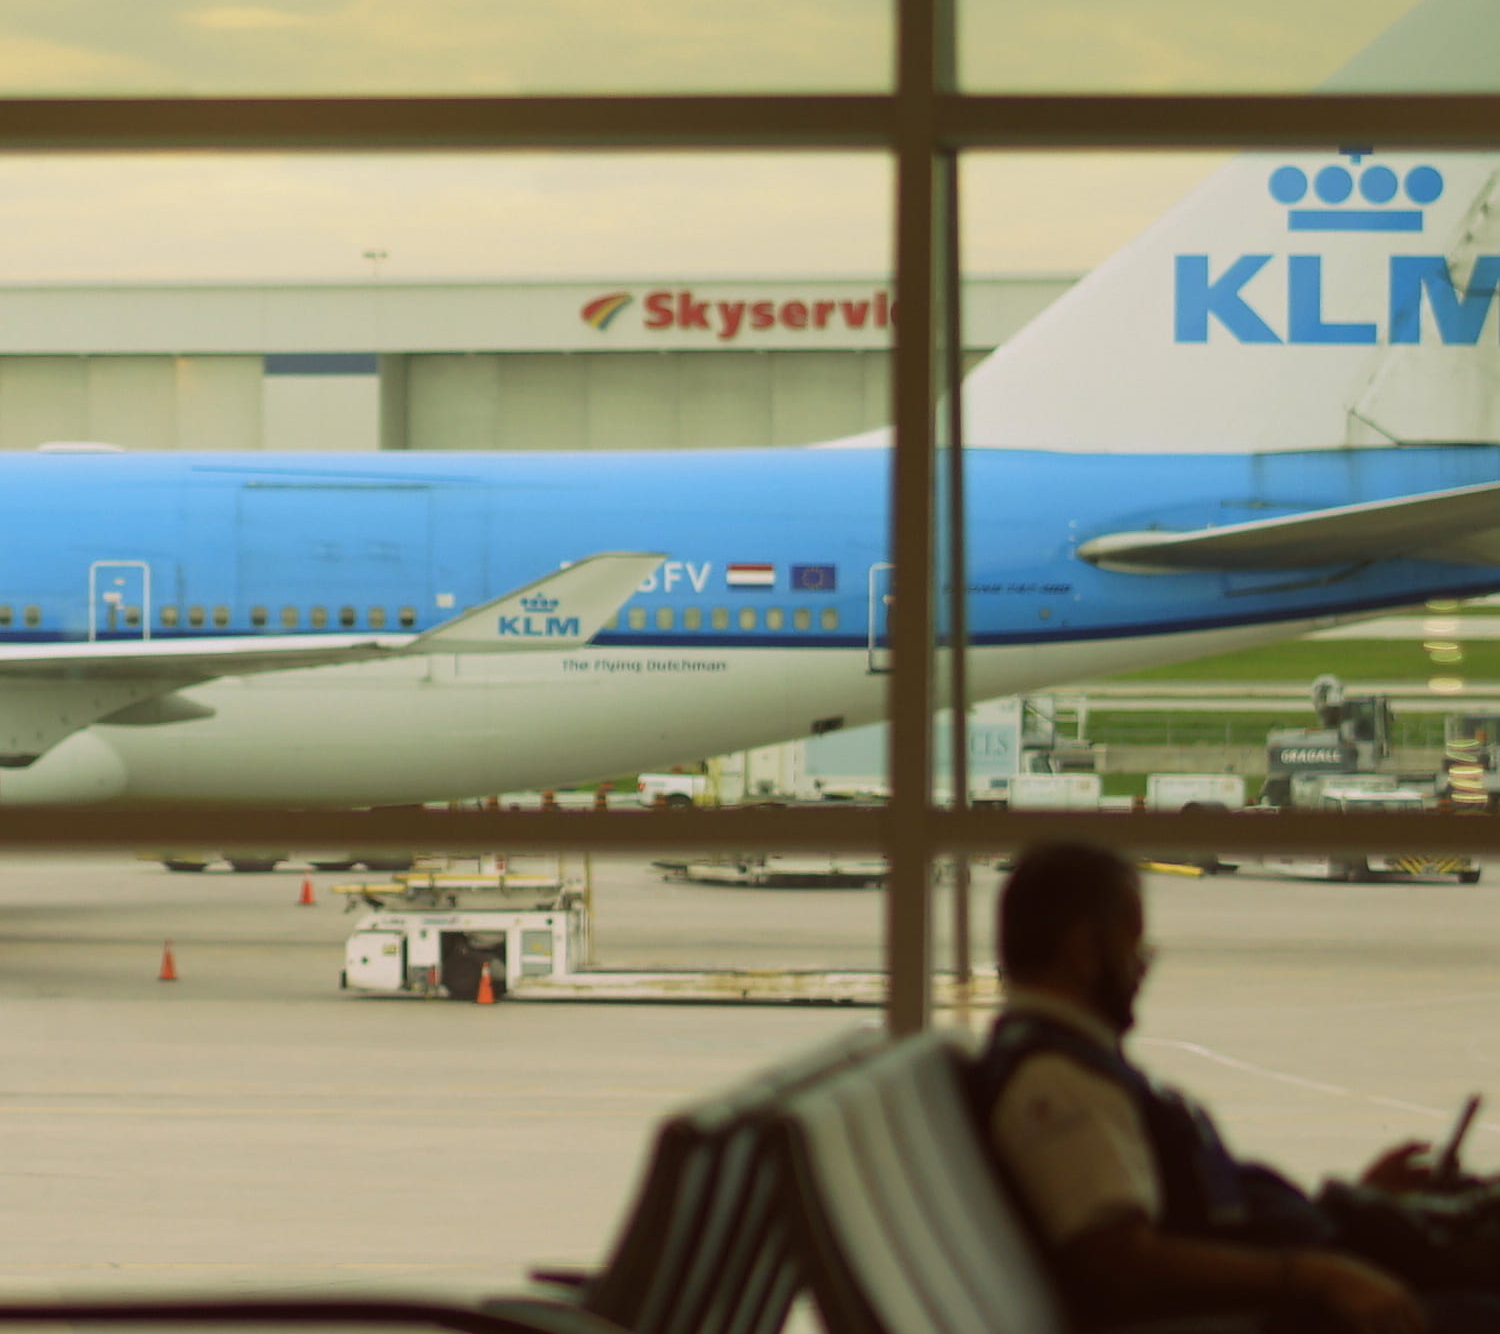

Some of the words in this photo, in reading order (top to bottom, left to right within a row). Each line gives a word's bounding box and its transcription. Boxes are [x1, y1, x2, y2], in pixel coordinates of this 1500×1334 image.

[642, 290, 899, 341] Skyservi
[498, 616, 580, 636] KLM
[561, 659, 589, 672] The
[594, 659, 641, 673] Flying
[646, 659, 728, 672] Dutchman
